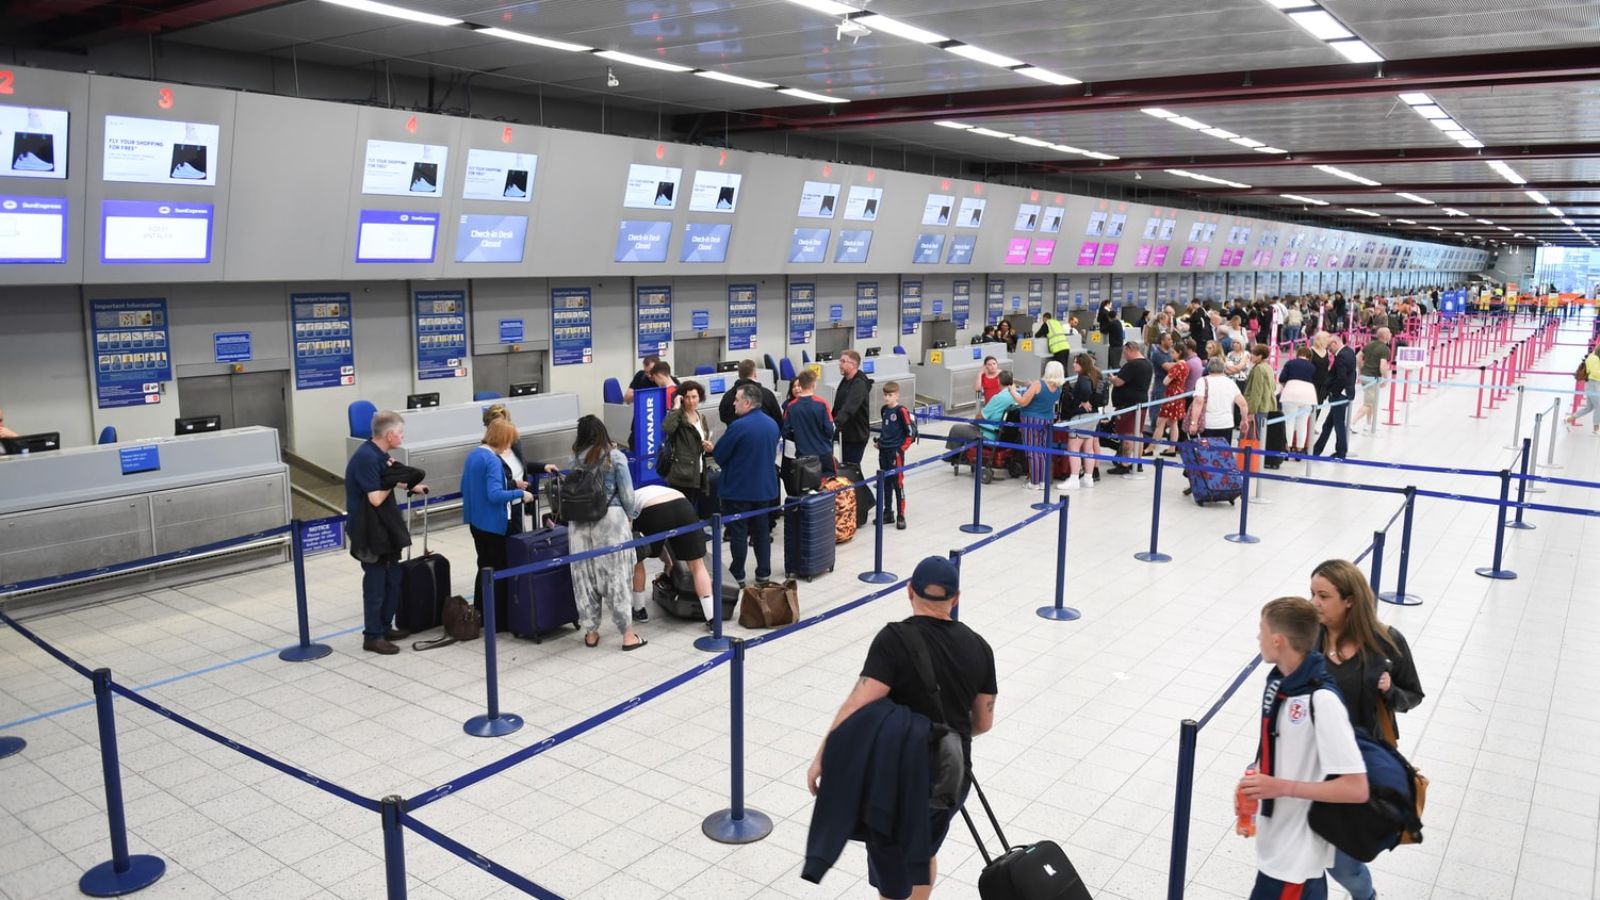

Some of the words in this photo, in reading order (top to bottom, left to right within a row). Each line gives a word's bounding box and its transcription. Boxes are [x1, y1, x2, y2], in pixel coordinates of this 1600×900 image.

[0, 70, 15, 94] 2
[158, 88, 174, 110] 3
[406, 116, 417, 134] 4
[502, 127, 512, 144] 5
[309, 524, 330, 532] NOTICE
